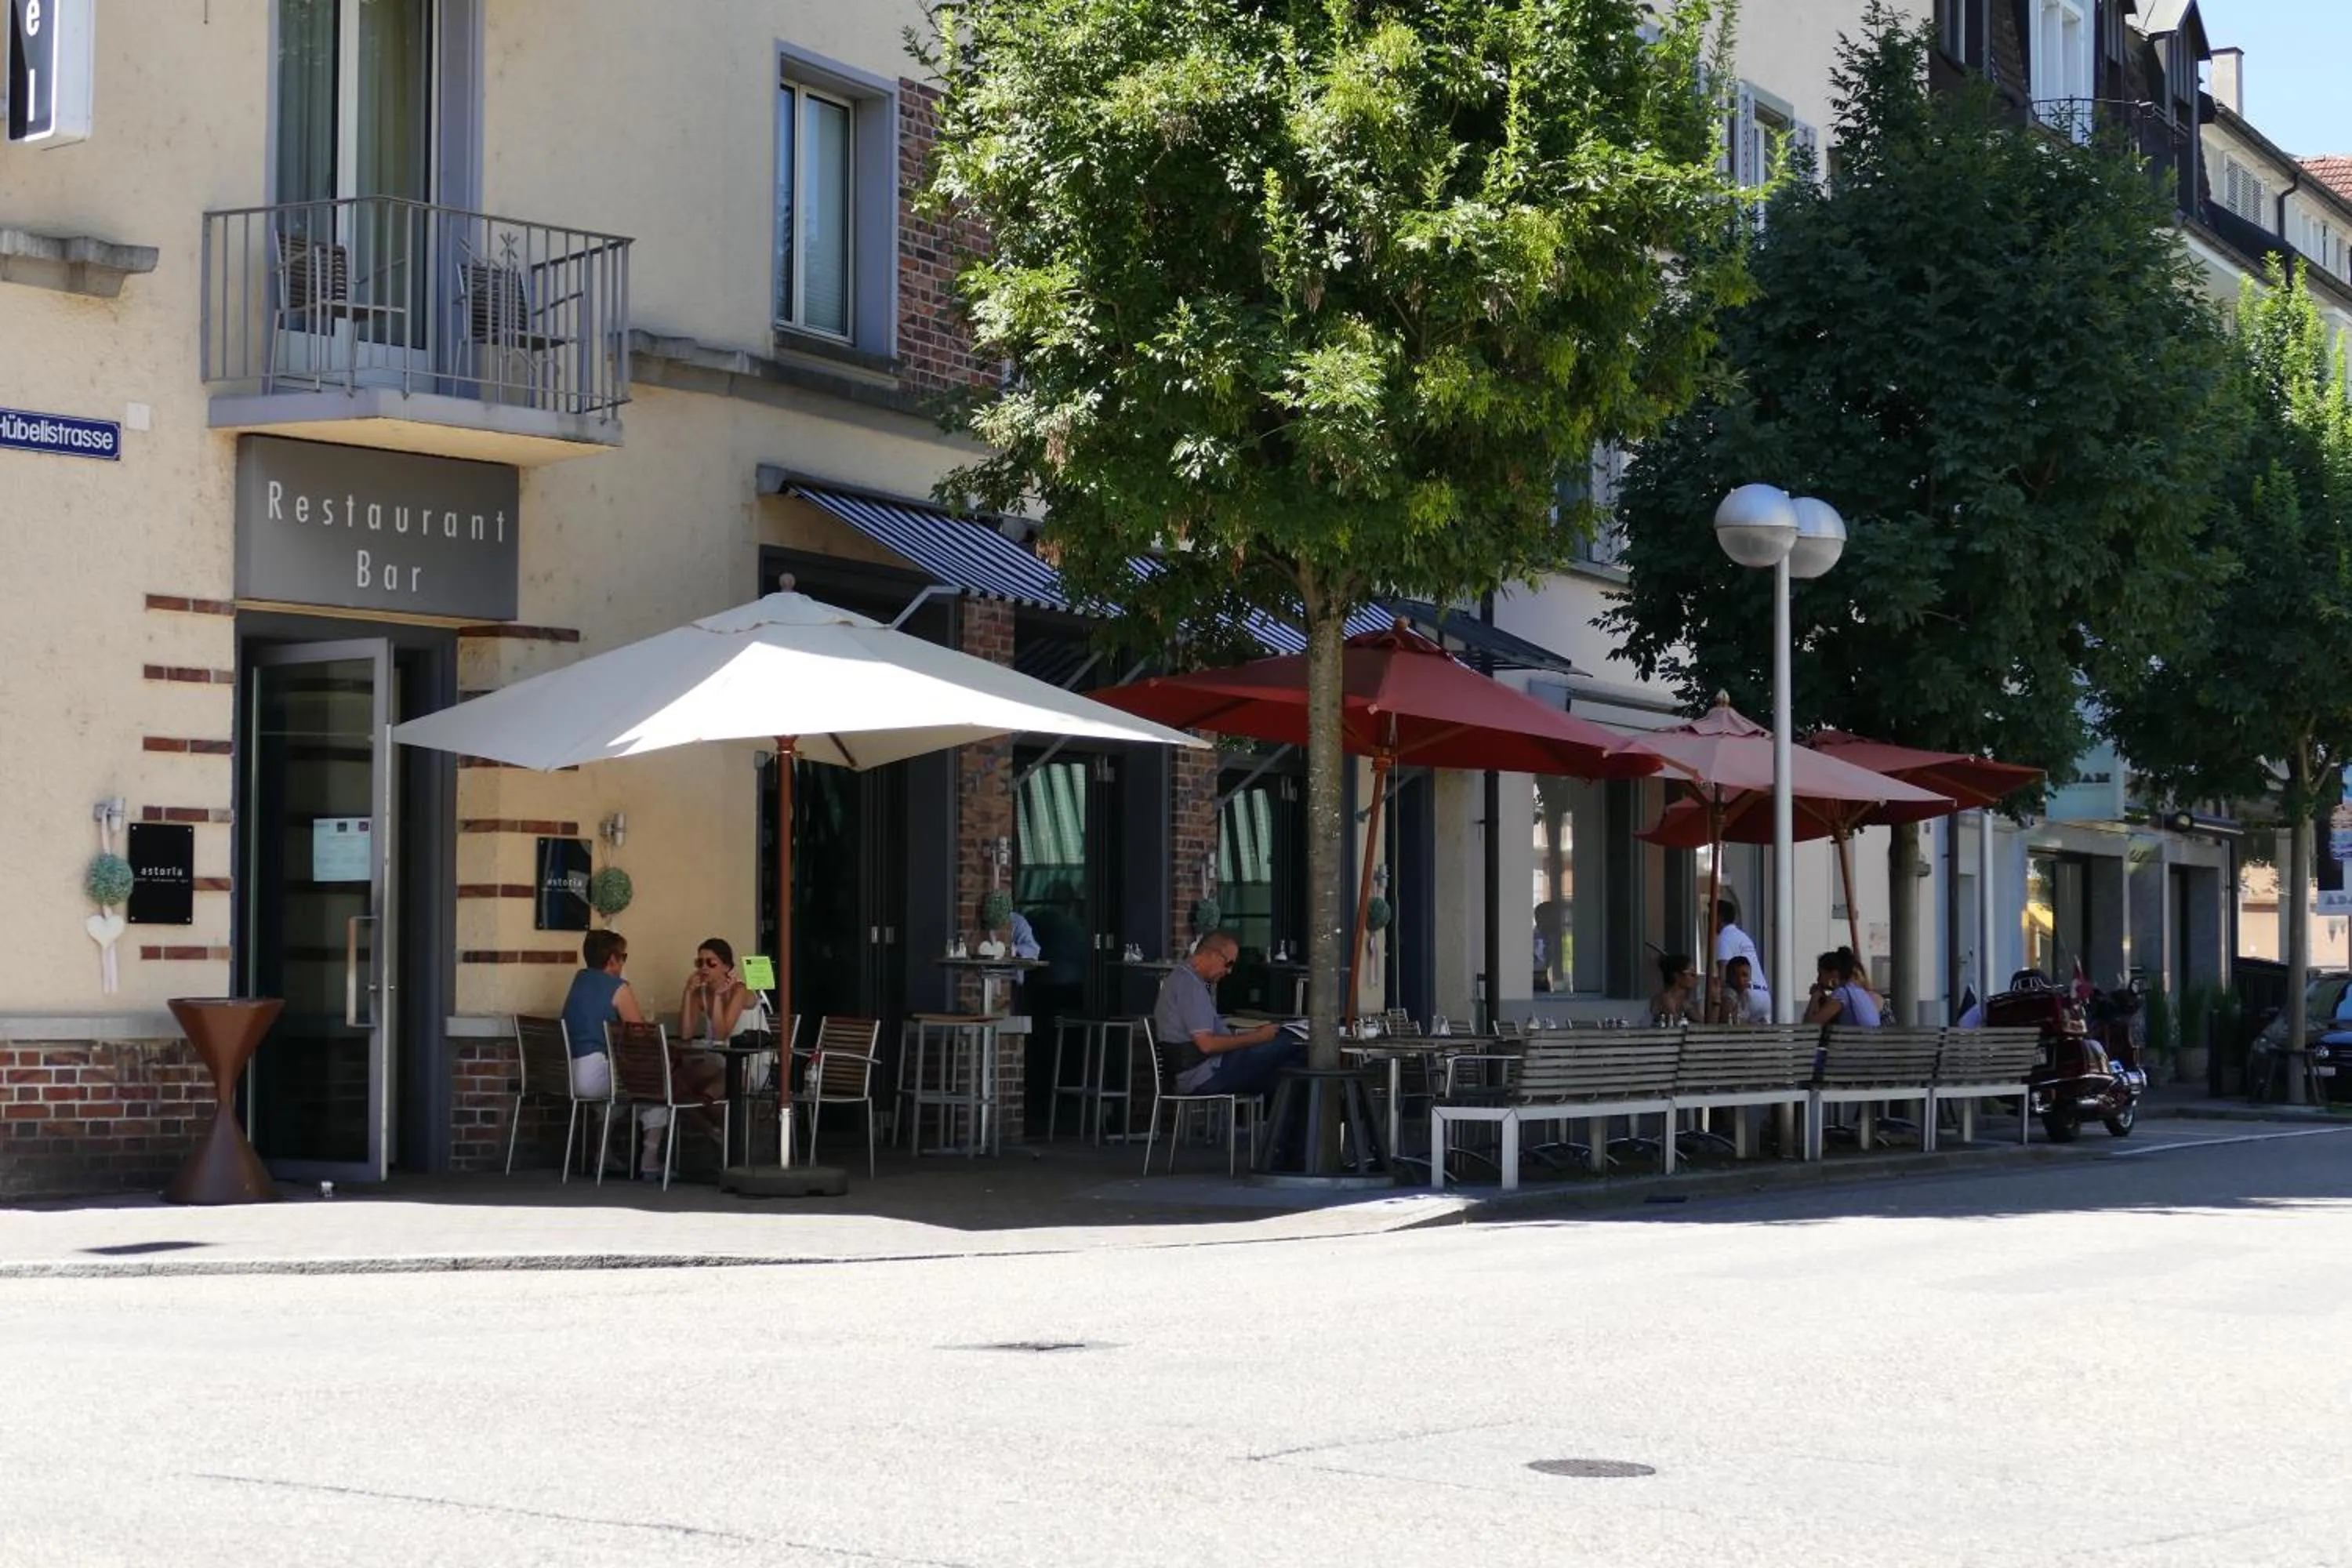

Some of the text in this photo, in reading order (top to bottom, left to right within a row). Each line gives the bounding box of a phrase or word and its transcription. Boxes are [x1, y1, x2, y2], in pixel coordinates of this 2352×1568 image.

[268, 481, 505, 542] Restaurant
[357, 550, 422, 592] Bar
[141, 866, 183, 877] astoria
